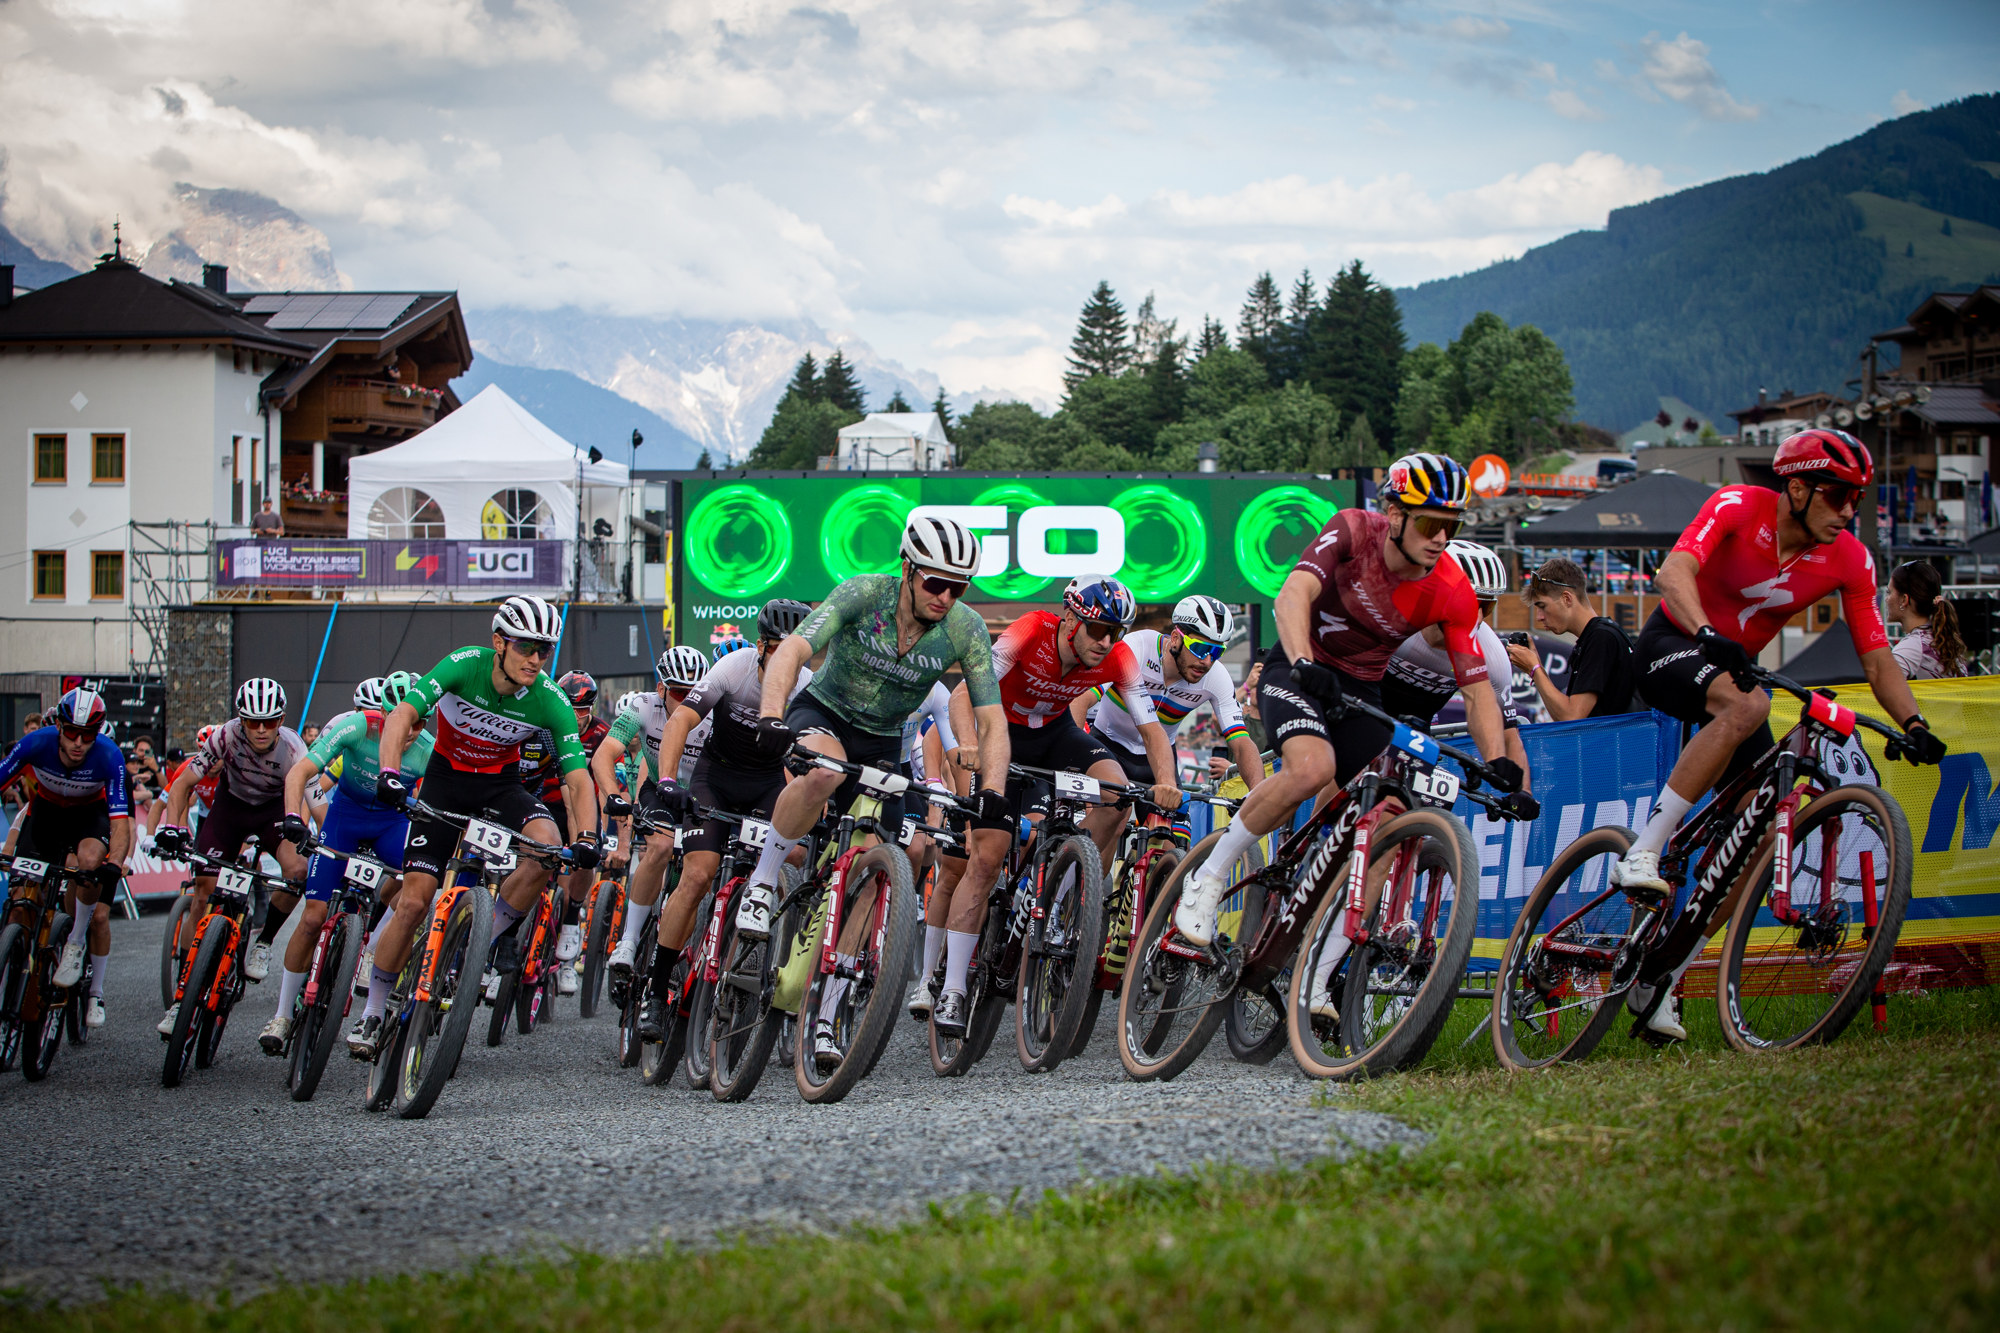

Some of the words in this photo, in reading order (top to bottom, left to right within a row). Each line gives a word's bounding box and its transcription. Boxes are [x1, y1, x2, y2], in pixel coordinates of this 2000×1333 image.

[1777, 458, 1830, 475] SPECIALIZED
[1519, 473, 1598, 488] MITTERER
[1695, 517, 1715, 542] SRAM
[906, 505, 1125, 577] GO
[263, 556, 328, 564] MOUNTAIN
[331, 556, 360, 564] BIKE
[267, 547, 287, 556] UCI
[264, 563, 312, 572] WORLD
[314, 563, 360, 572] SERIES
[479, 552, 528, 572] UCI
[505, 606, 521, 624] MET
[693, 605, 758, 619] WHOOP
[450, 648, 481, 663] Benexe
[857, 629, 943, 671] CANYON
[860, 651, 922, 683] ROCKSHOX
[1694, 663, 1717, 685] ROCK
[542, 679, 571, 707] Benexe
[456, 701, 534, 734] Wilier
[503, 708, 526, 718] SHIMANO
[1827, 702, 1838, 722] 1
[468, 722, 518, 745] vittoria
[1275, 717, 1327, 739] ROCKSHOX
[1408, 729, 1425, 753] 2
[1434, 771, 1454, 781] URTER
[1071, 780, 1085, 791] 3
[1425, 777, 1450, 797] 10
[527, 812, 555, 821] vittoria
[477, 826, 503, 849] 13
[1685, 778, 1776, 923] S-WORKS
[19, 860, 42, 871] 20
[354, 864, 375, 882] 19
[411, 860, 439, 873] vittoria
[1281, 800, 1361, 934] S-WORKS
[225, 873, 247, 889] 17
[436, 917, 450, 933] 3
[1166, 943, 1197, 957] SPECIALIZED
[1550, 942, 1587, 953] SPECIALIZED
[424, 948, 439, 980] FOX
